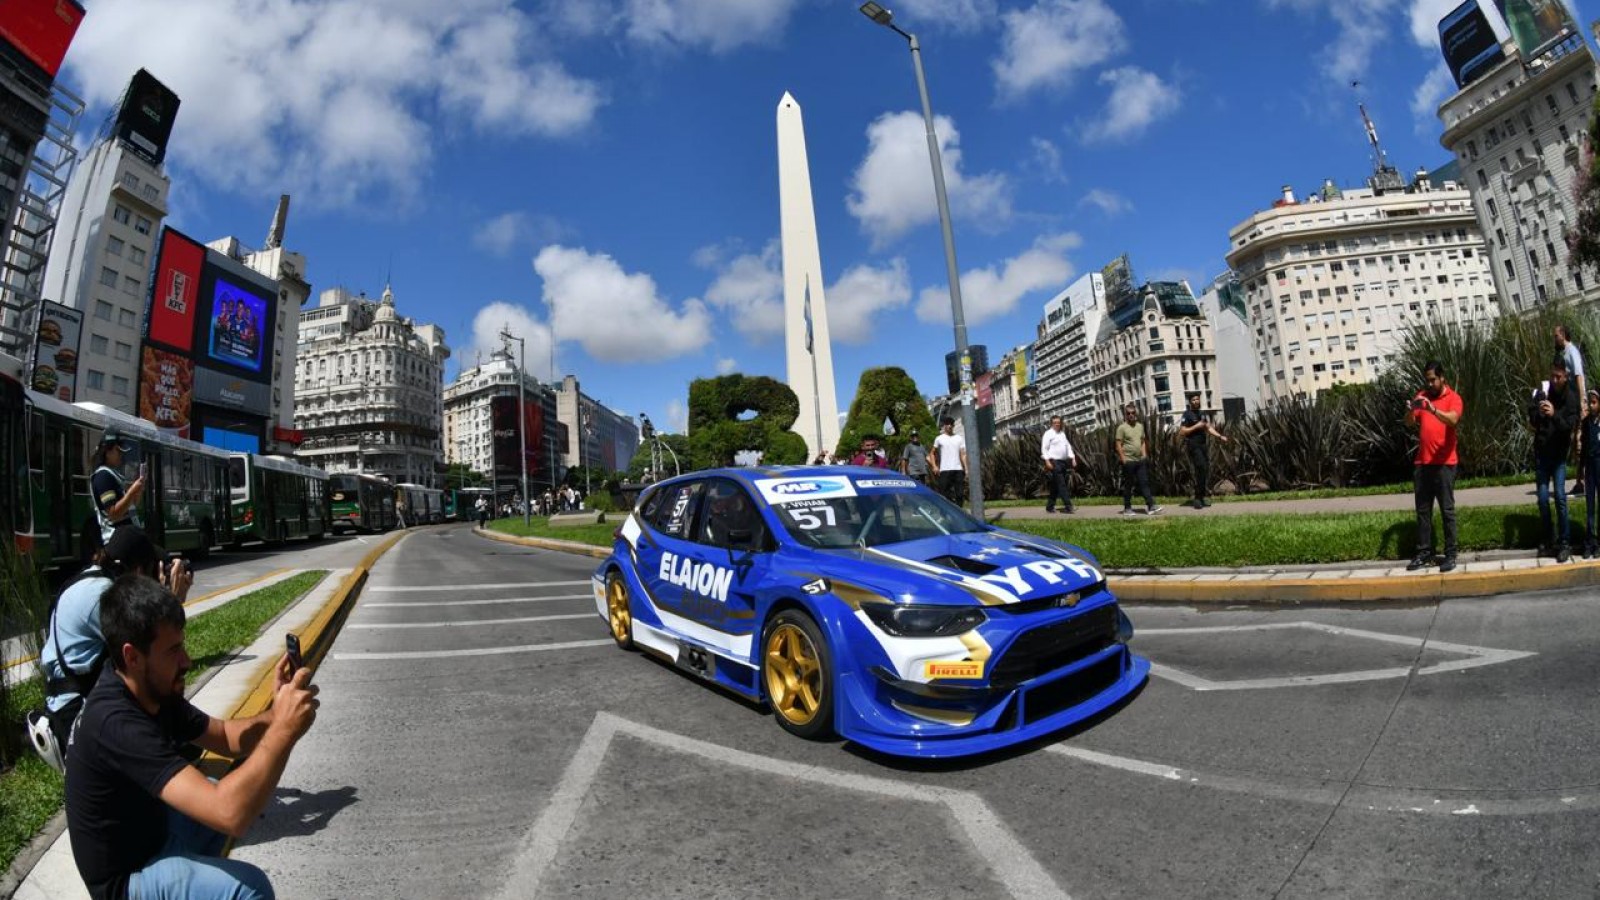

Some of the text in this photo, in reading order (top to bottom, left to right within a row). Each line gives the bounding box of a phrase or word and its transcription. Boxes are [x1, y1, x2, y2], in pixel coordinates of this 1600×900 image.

[156, 406, 179, 421] KFC
[673, 499, 688, 517] 57
[790, 499, 826, 507] VIVIAN
[788, 505, 836, 530] 57
[659, 551, 734, 602] ELAION
[985, 558, 1100, 596] YPF
[802, 579, 826, 594] 57
[930, 665, 978, 676] PIRELLI
